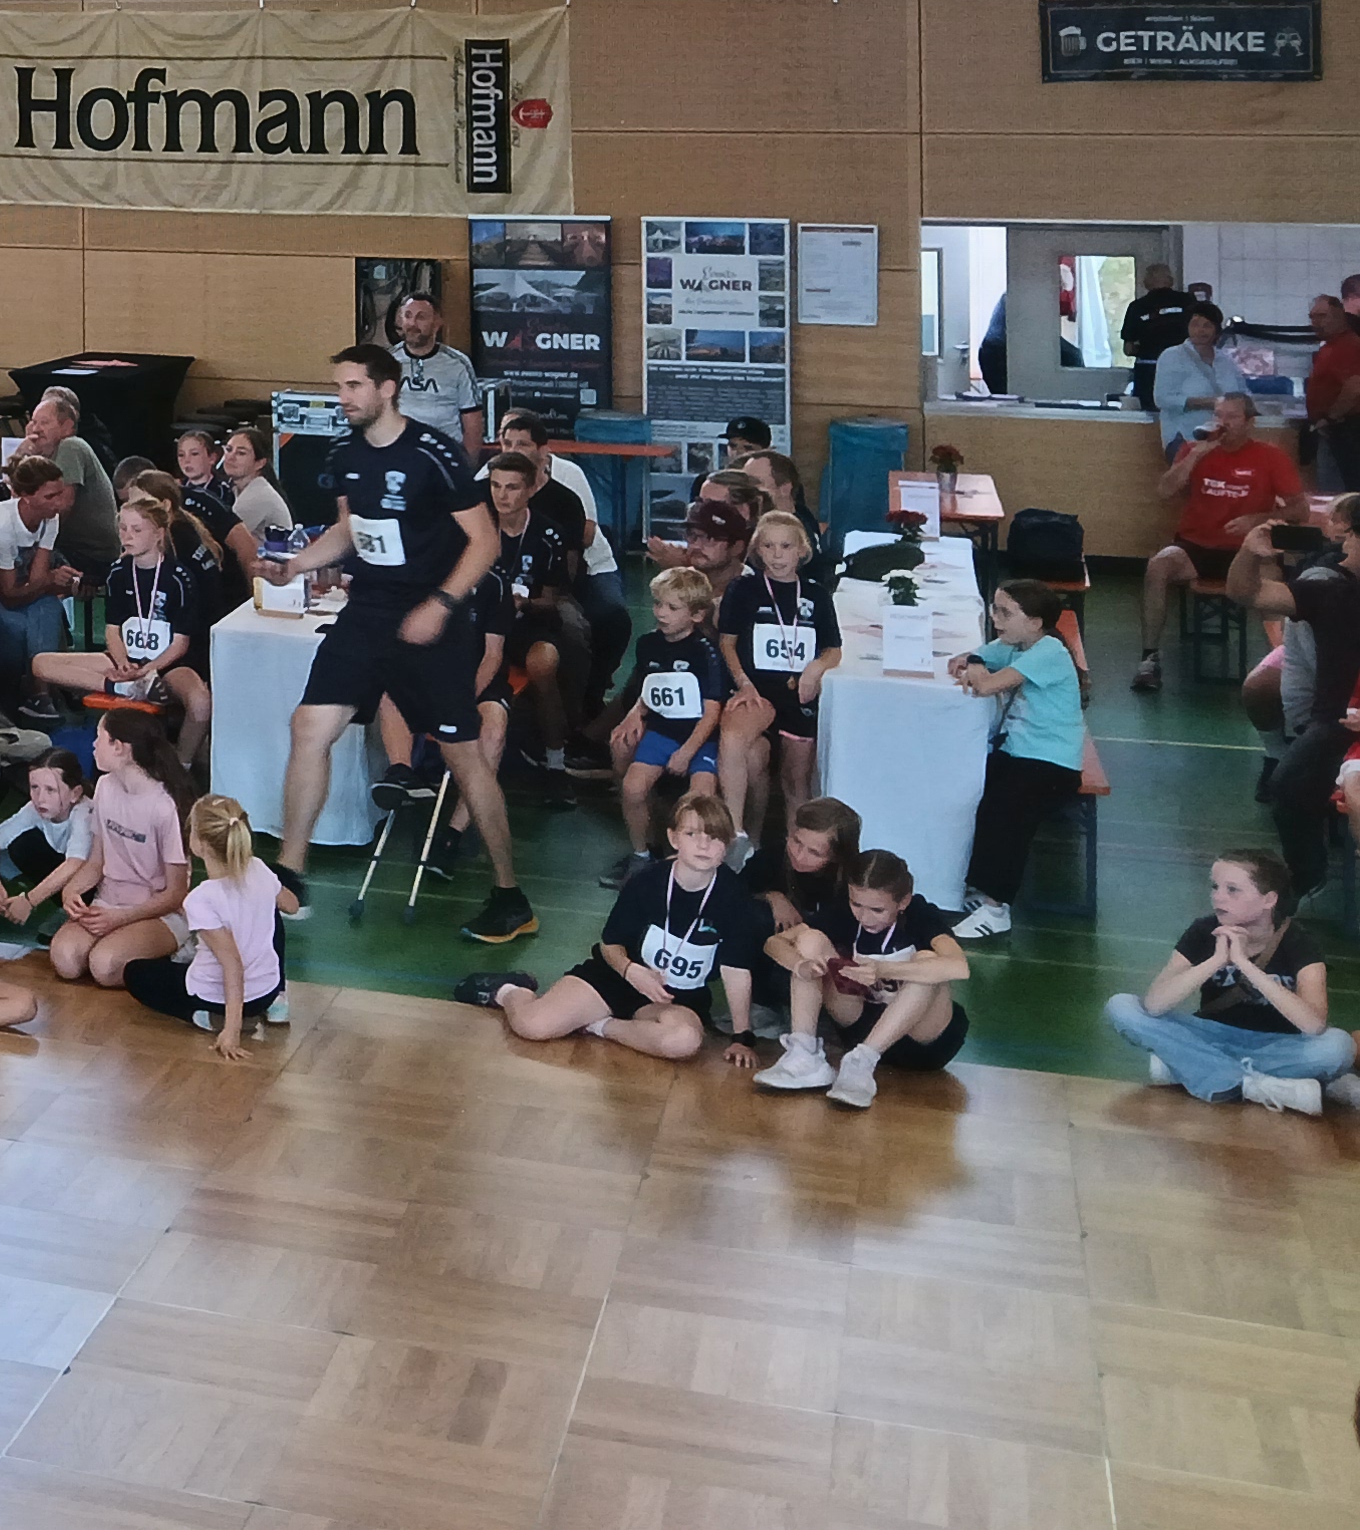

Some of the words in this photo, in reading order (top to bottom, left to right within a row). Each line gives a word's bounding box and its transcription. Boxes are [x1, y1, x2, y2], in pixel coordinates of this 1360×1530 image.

[1096, 25, 1266, 52] GETRÄNKE
[13, 66, 422, 156] Hofmann
[471, 47, 504, 184] Hofmann
[679, 279, 753, 292] WAGNER
[126, 629, 160, 651] 668
[765, 638, 806, 661] 654
[650, 686, 685, 707] 661
[653, 948, 705, 980] 695
